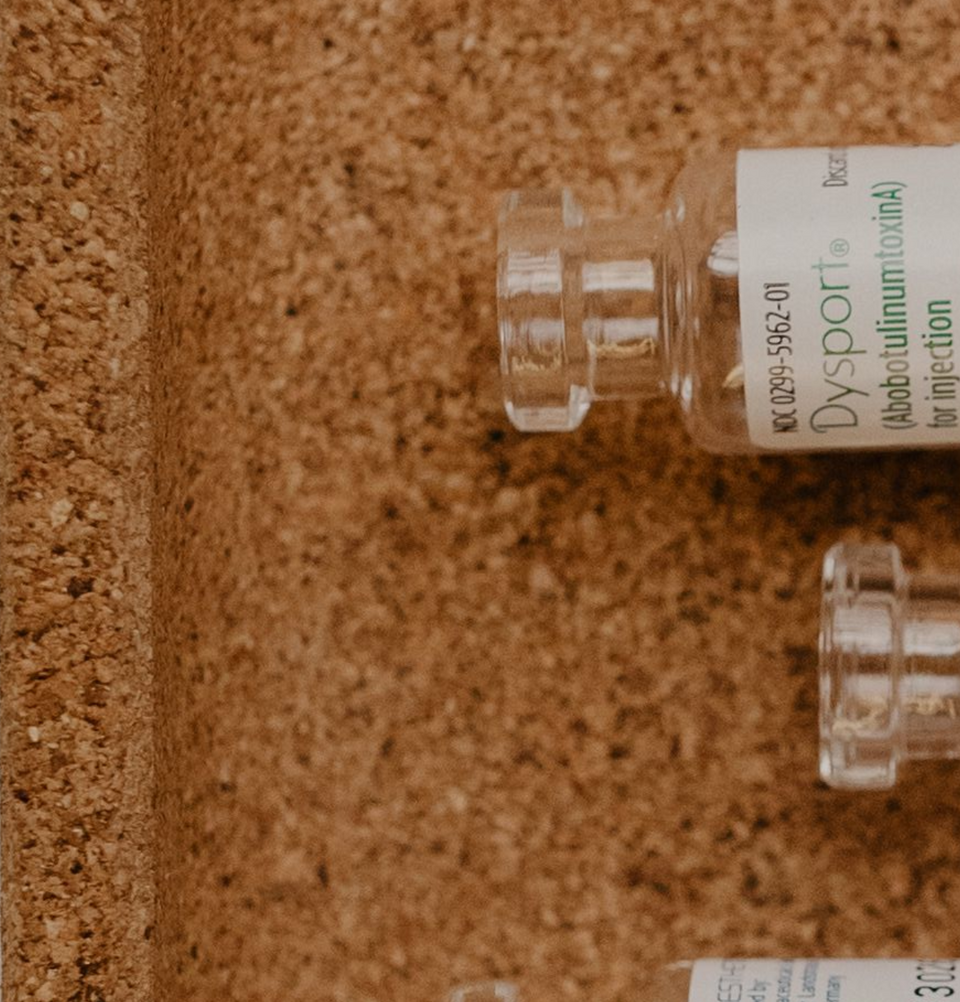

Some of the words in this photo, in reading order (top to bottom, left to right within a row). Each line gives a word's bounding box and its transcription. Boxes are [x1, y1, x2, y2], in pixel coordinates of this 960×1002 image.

[870, 181, 918, 430] (AbobotulinumtoxinA)
[763, 282, 795, 405] 0299-5962-01
[772, 409, 798, 433] NDC
[926, 406, 959, 428] for
